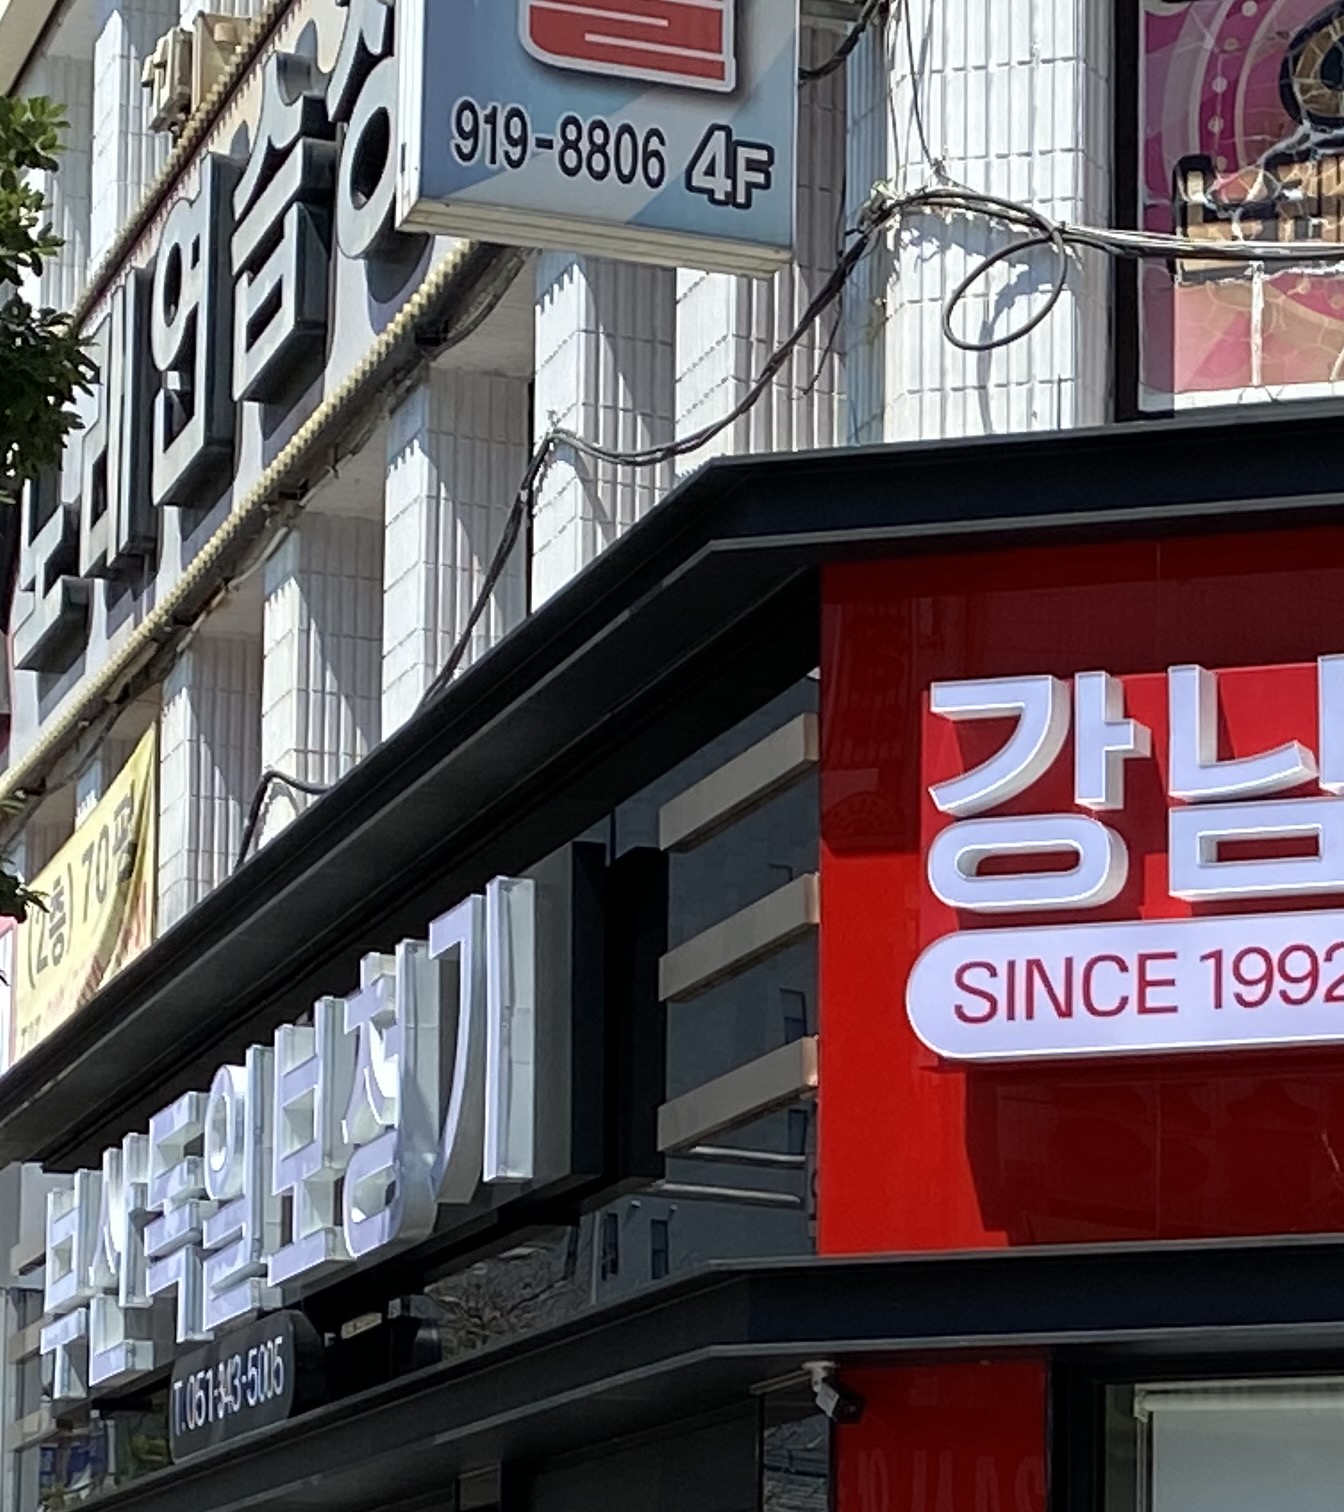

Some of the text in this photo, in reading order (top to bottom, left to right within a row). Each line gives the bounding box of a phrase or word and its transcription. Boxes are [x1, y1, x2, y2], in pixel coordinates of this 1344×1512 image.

[453, 97, 775, 209] 919-8806 4F
[951, 946, 1181, 1026] SINCE
